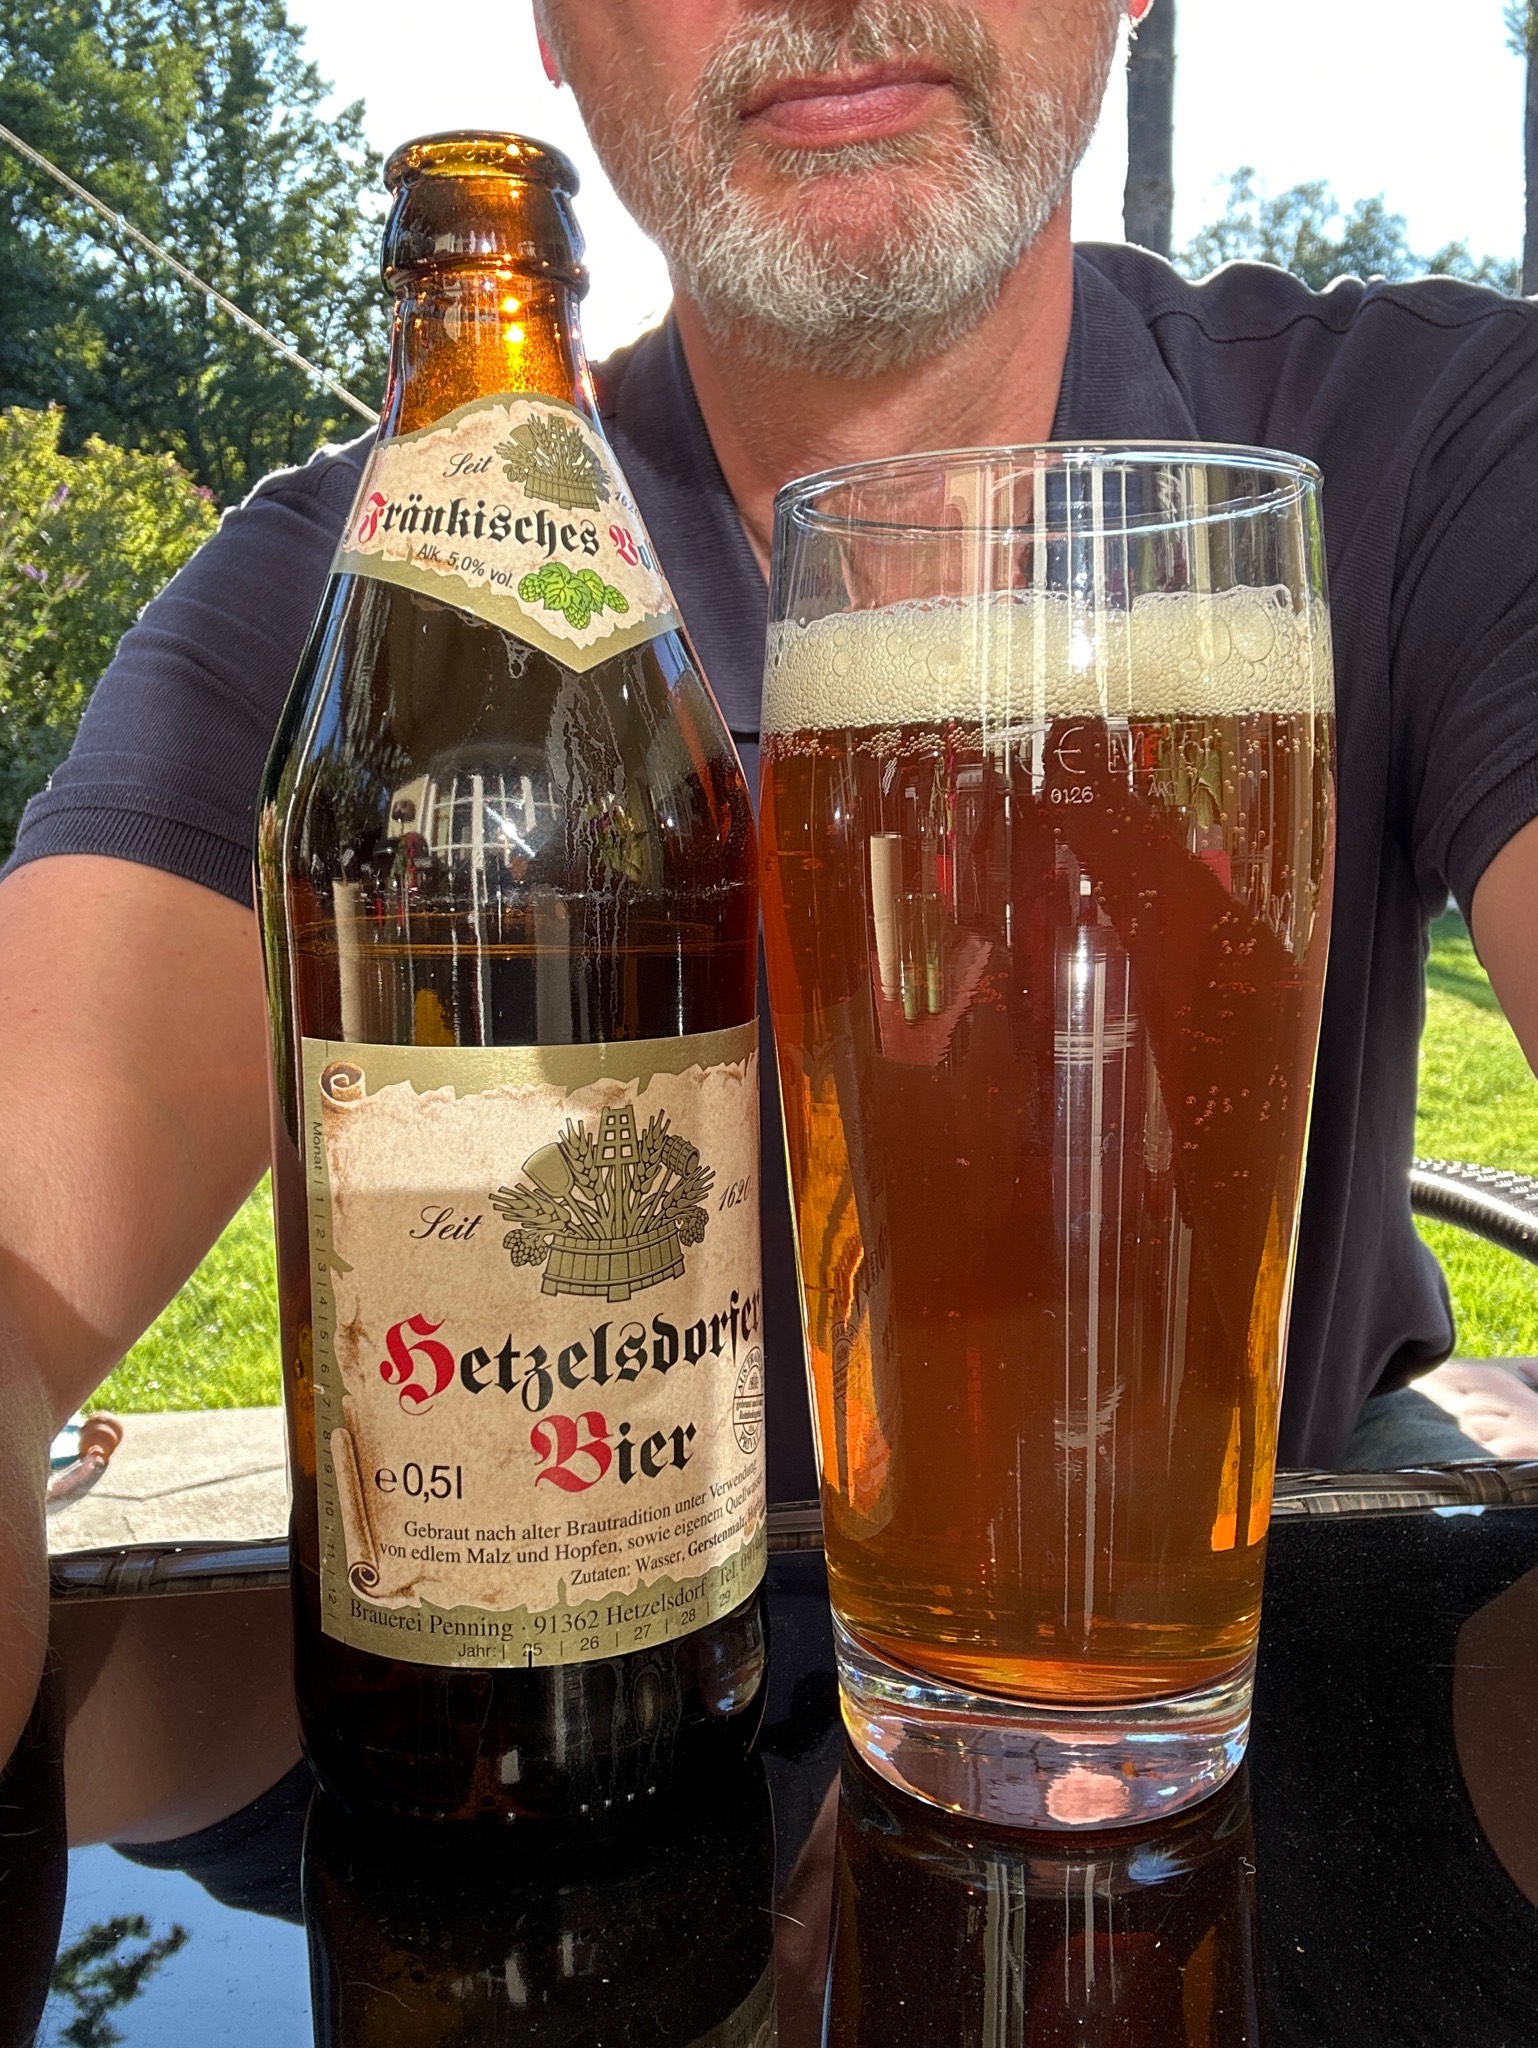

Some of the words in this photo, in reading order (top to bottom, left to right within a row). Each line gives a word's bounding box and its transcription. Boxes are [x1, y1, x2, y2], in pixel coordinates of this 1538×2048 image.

[442, 453, 493, 477] Seit
[358, 491, 601, 560] Fränkisches
[447, 551, 485, 577] 5,0%
[490, 568, 513, 589] vol.
[1051, 786, 1094, 804] 0126
[315, 1195, 324, 1203] 1
[409, 1205, 482, 1241] Seit
[718, 1175, 751, 1212] 1620
[316, 1228, 326, 1239] 2
[317, 1262, 327, 1273] 3
[318, 1295, 328, 1306] 4
[319, 1329, 329, 1341] 5
[380, 1286, 760, 1416] Hetzelsdorfer
[320, 1363, 330, 1374] 6
[321, 1397, 331, 1408] 7
[322, 1430, 332, 1441] 8
[530, 1410, 697, 1493] Bier
[323, 1463, 333, 1474] 9
[324, 1499, 335, 1517] 10
[404, 1520, 470, 1541] Gebraut
[476, 1524, 516, 1541] nach
[522, 1523, 561, 1541] alter
[566, 1505, 671, 1537] Brautradition
[675, 1492, 707, 1514] unter
[710, 1458, 757, 1499] Verwendung
[380, 1542, 406, 1559] von
[411, 1546, 461, 1563] edlem
[467, 1548, 511, 1564] Malz
[517, 1546, 549, 1563] und
[555, 1539, 623, 1563] Hopfen,
[628, 1527, 671, 1550] sowie
[674, 1506, 723, 1536] eigenem
[325, 1542, 336, 1560] 11
[570, 1564, 631, 1586] Zutaten:
[635, 1549, 685, 1574] Wasser,
[327, 1587, 338, 1606] 12
[351, 1599, 422, 1632] Brauerei
[429, 1614, 514, 1642] Penning
[534, 1609, 599, 1634] 91362
[606, 1577, 707, 1627] Hetzelsdorf
[718, 1564, 739, 1588] Tel.
[458, 1642, 496, 1659] Jahr:
[522, 1643, 542, 1657] 25
[580, 1635, 600, 1651] 26
[634, 1624, 651, 1641] 27
[681, 1608, 696, 1626] 28
[719, 1590, 731, 1608] 29
